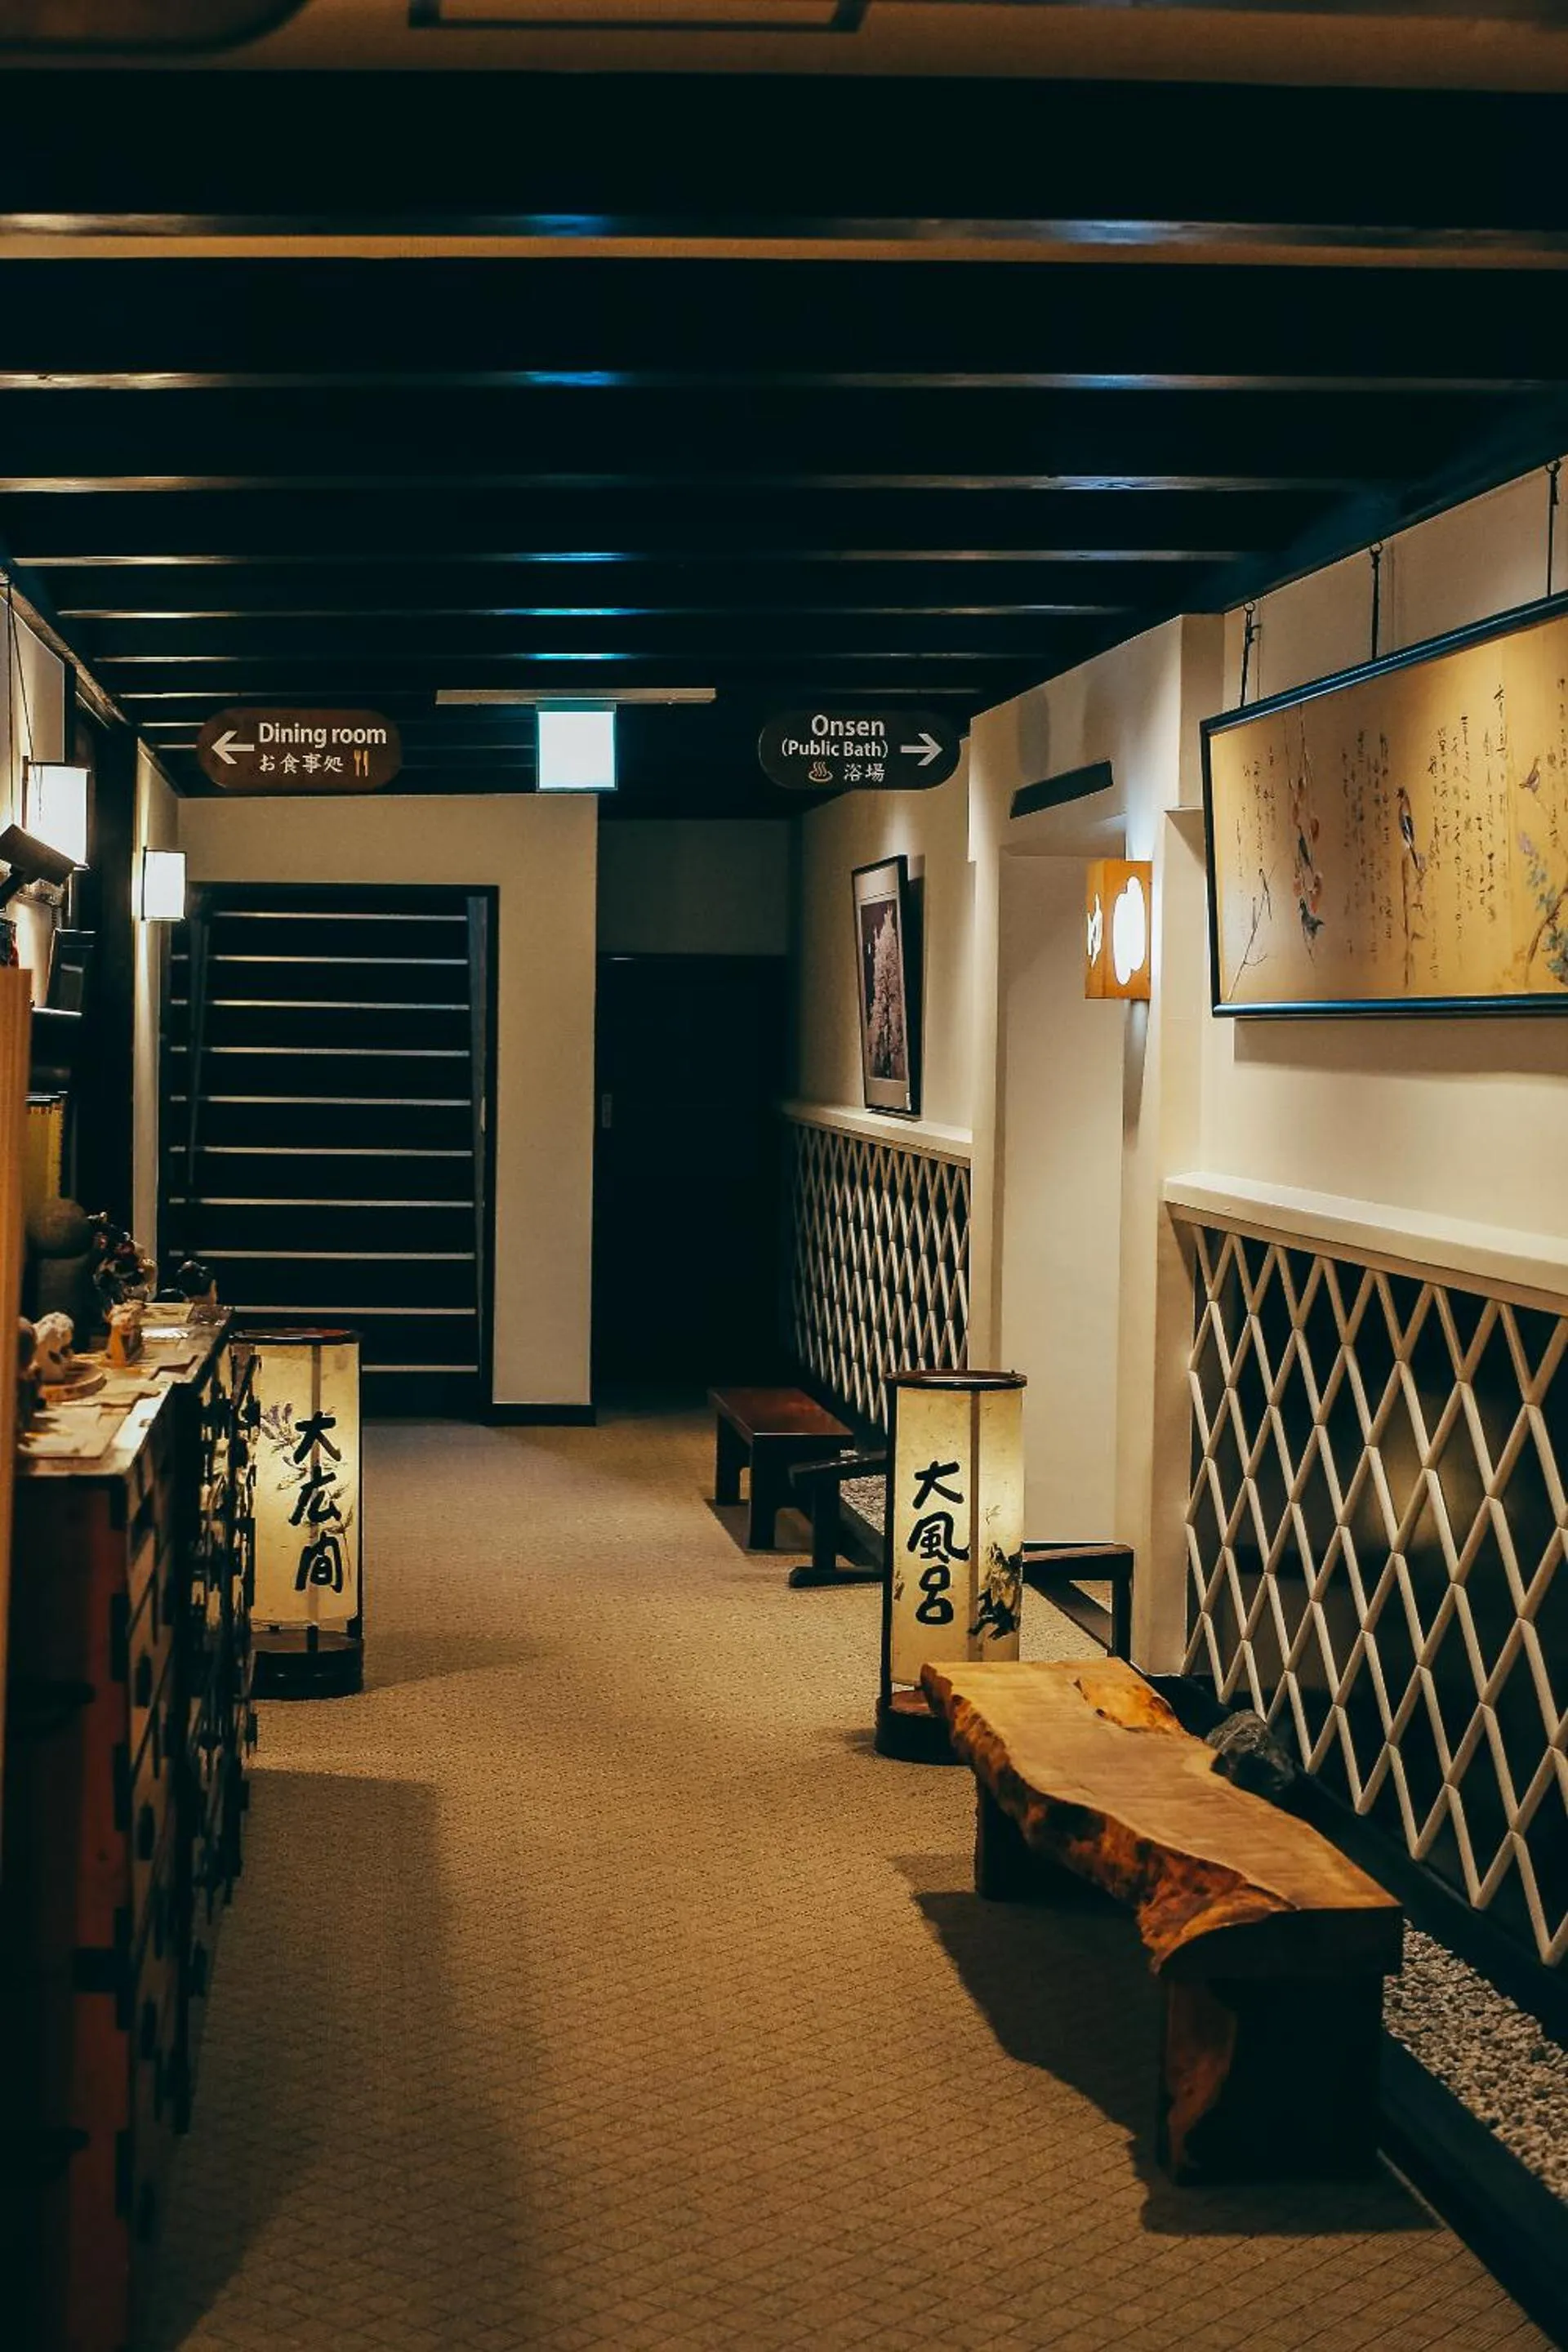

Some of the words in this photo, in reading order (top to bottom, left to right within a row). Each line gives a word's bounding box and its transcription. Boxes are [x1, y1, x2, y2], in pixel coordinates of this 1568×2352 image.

[258, 722, 327, 748] Dining
[332, 728, 387, 745] room
[811, 714, 884, 737] Onsen
[782, 737, 840, 757] (Public
[843, 739, 889, 759] Bath)
[259, 753, 344, 774] お食事処
[844, 763, 885, 782] 浴場
[1087, 893, 1103, 969] ゆ
[907, 1460, 971, 1625] 大風呂
